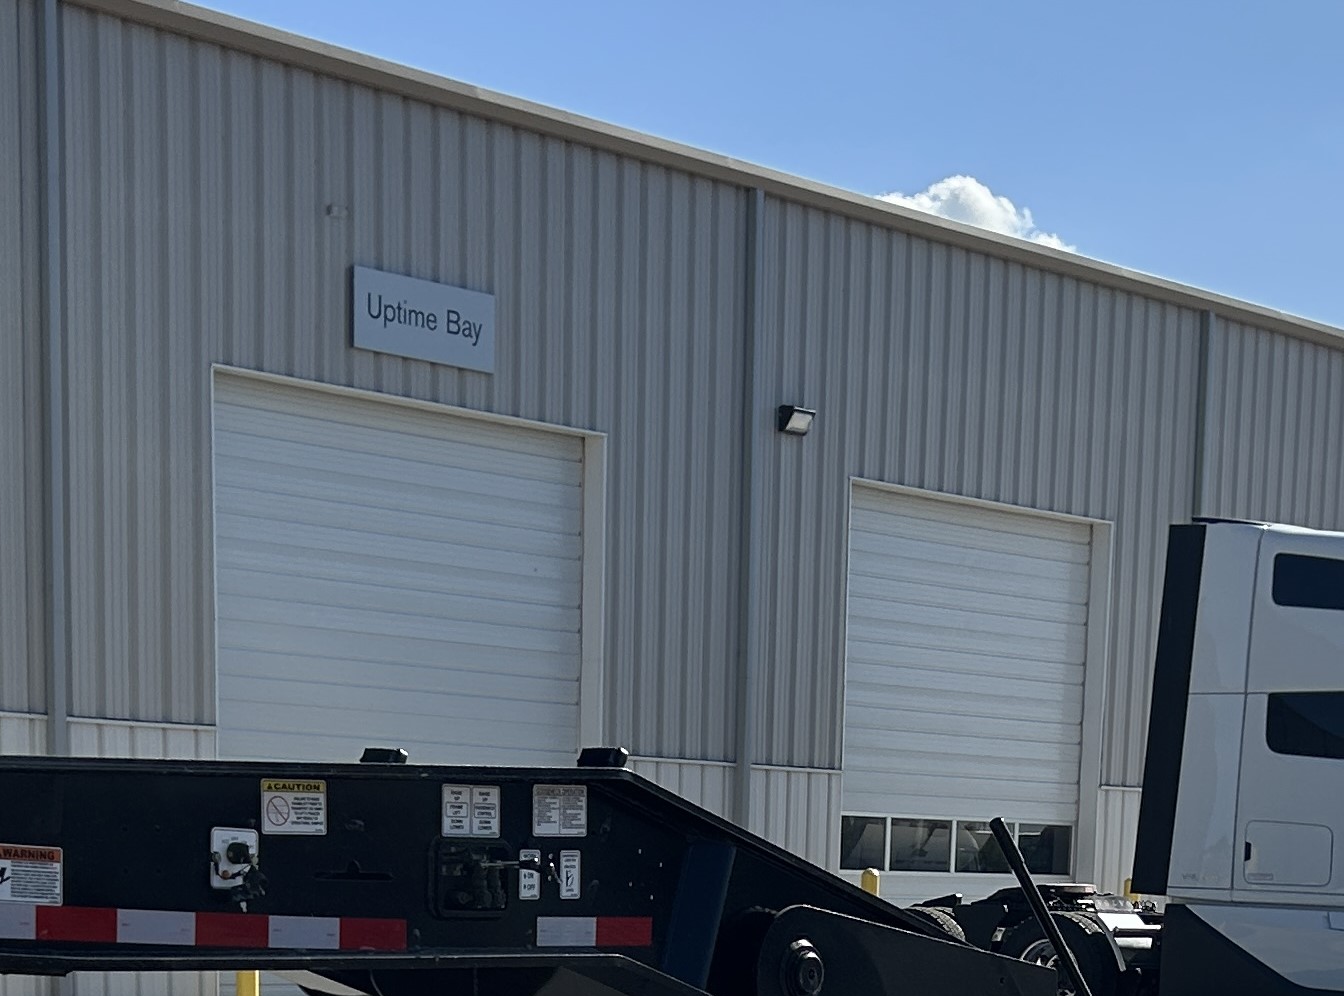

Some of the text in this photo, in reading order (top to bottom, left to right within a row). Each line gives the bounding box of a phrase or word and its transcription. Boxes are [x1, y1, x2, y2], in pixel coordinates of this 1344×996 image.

[367, 292, 483, 347] Uptime Bay
[274, 783, 320, 791] CAUTION
[2, 848, 55, 861] WARNING
